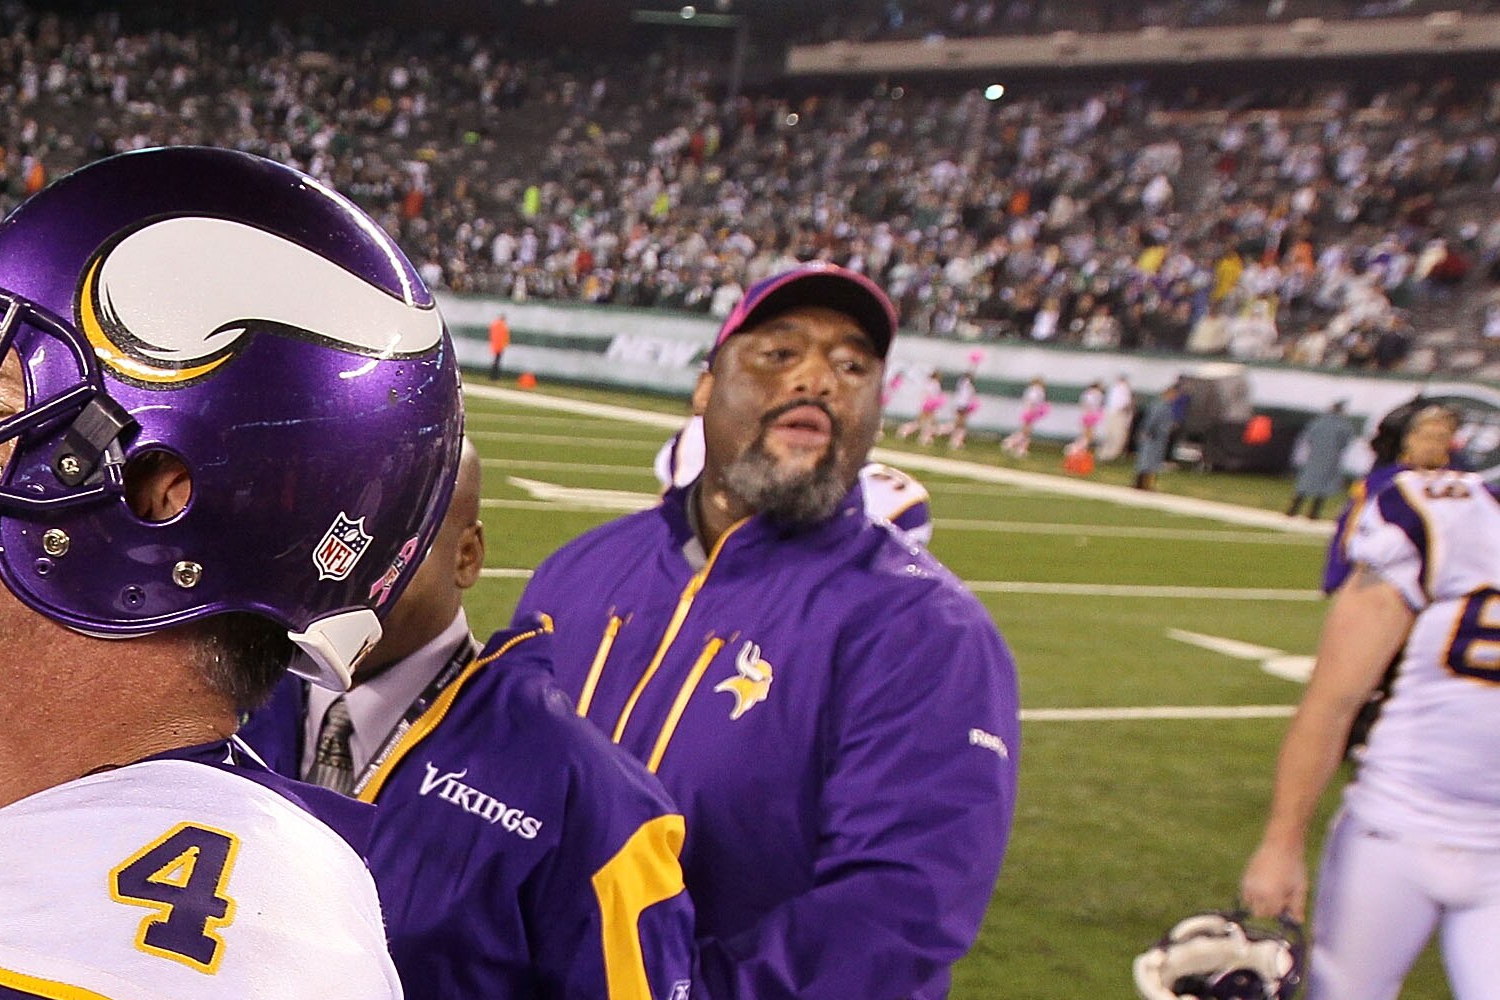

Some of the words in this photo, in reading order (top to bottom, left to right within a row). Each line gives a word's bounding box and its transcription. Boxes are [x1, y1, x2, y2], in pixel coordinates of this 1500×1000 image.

[319, 536, 352, 574] NFL
[418, 761, 543, 840] VIKINGS
[108, 821, 242, 976] 4
